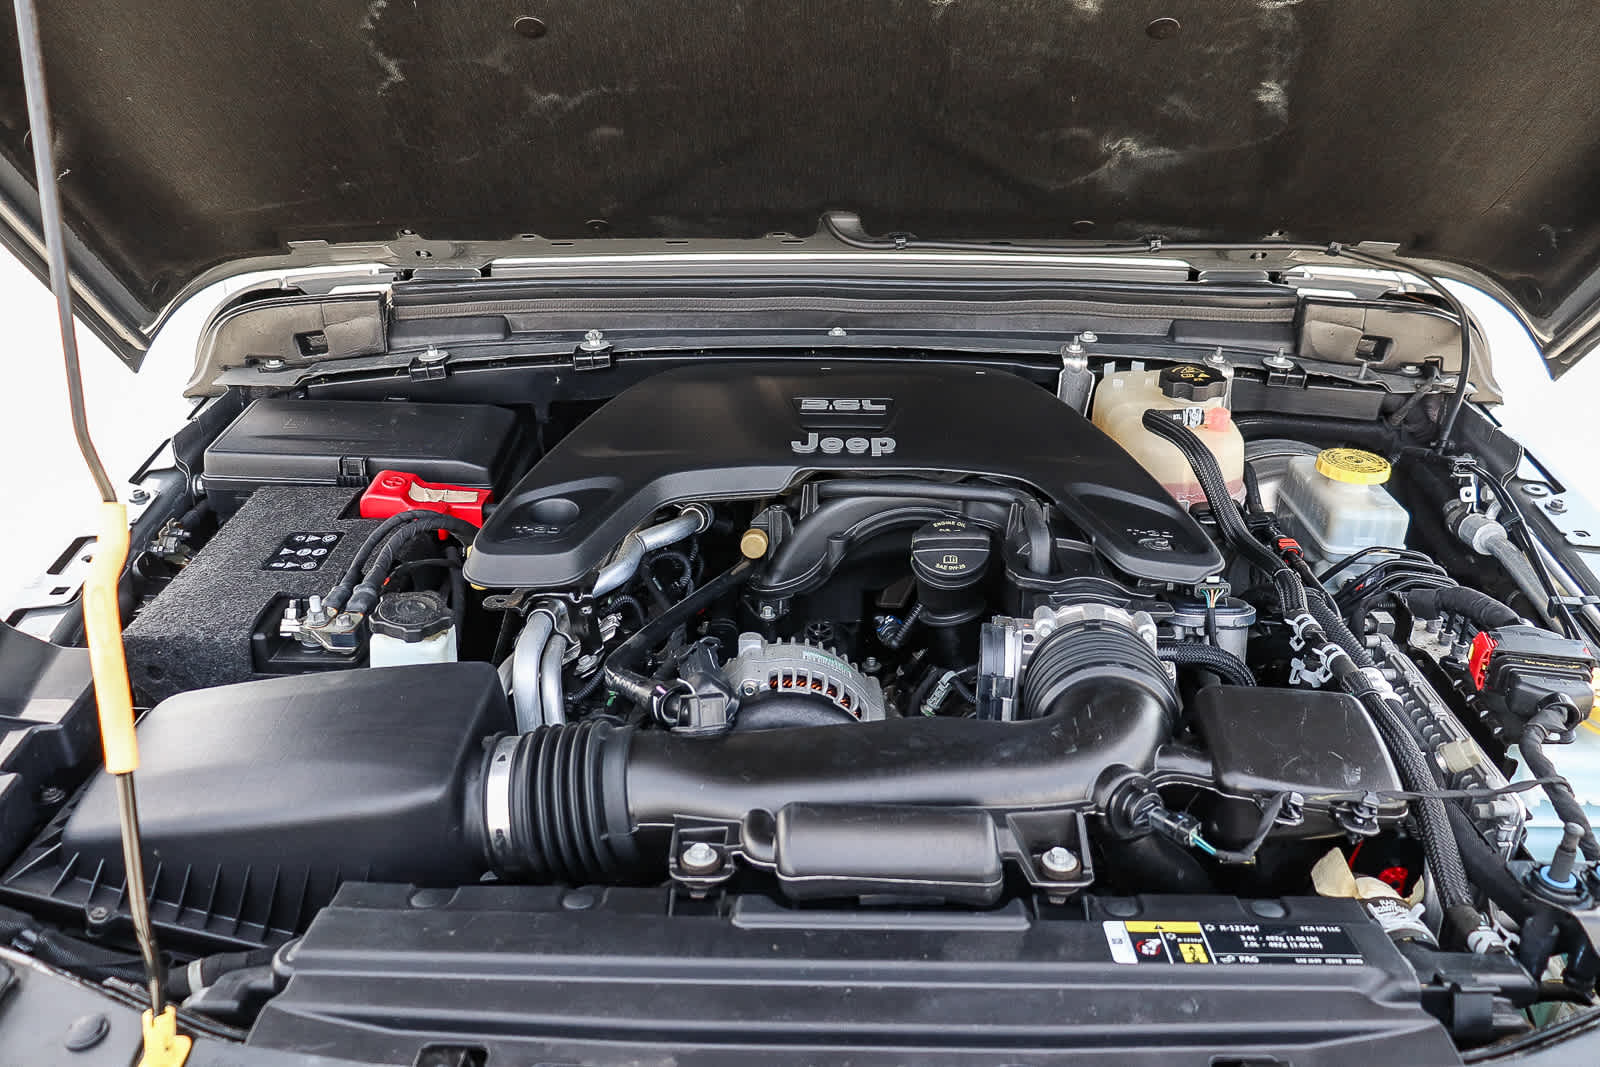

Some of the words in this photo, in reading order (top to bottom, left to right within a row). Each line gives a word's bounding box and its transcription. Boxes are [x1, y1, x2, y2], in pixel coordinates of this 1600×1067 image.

[801, 399, 886, 410] 3.6L
[791, 432, 896, 456] Jeep
[1238, 955, 1259, 963] PAG
